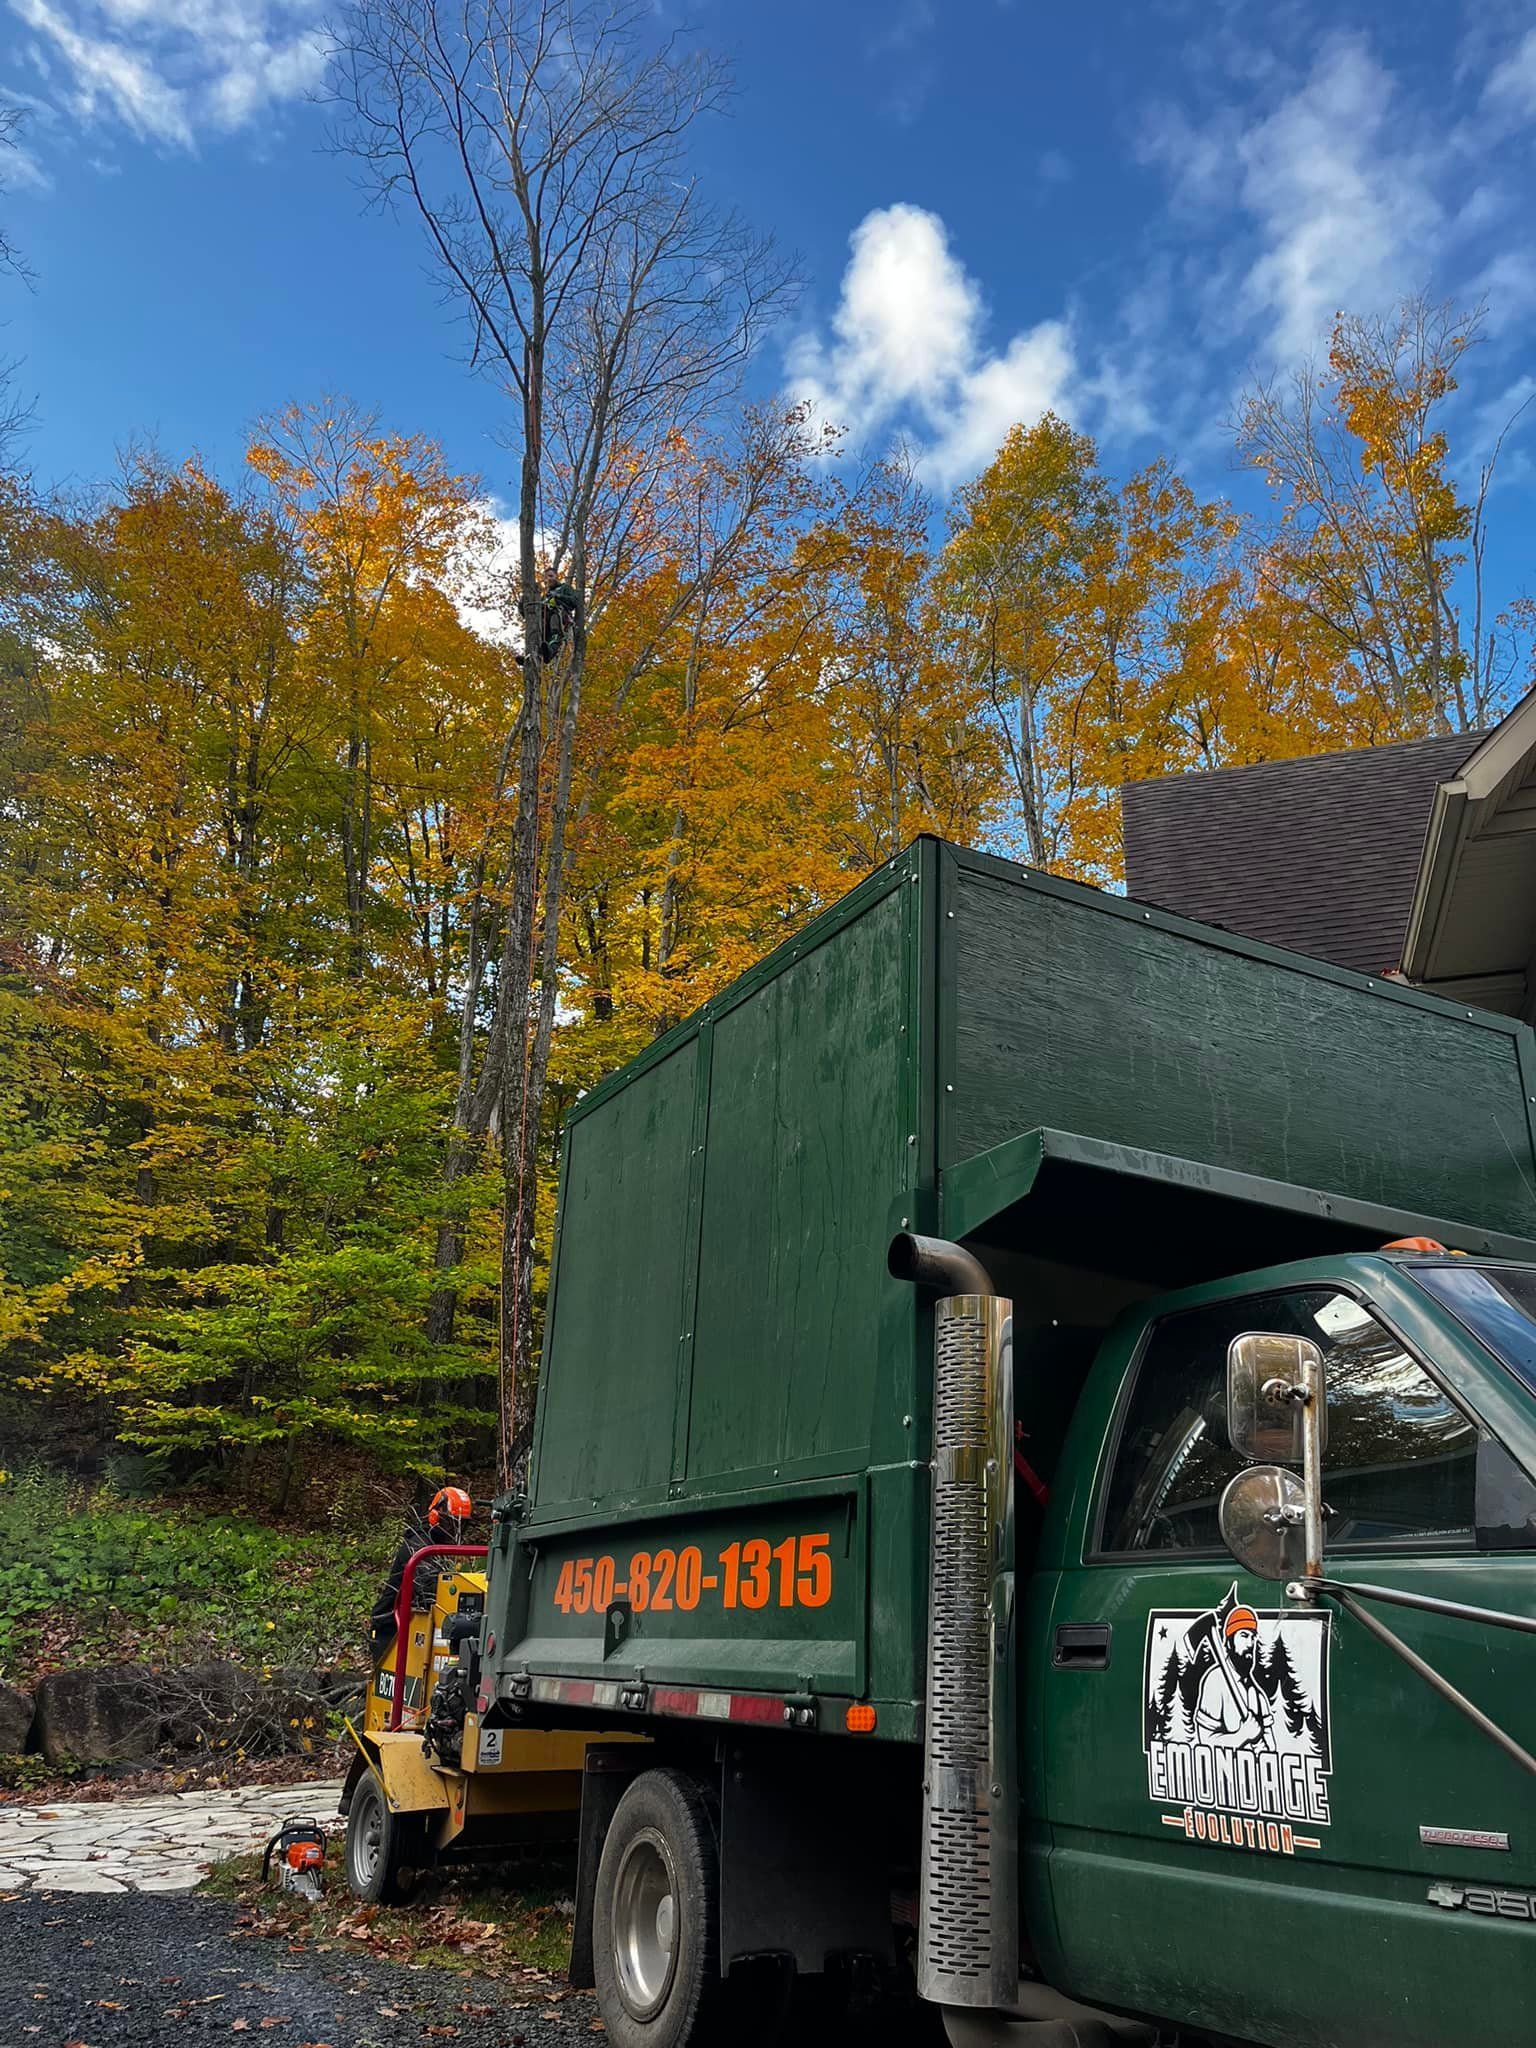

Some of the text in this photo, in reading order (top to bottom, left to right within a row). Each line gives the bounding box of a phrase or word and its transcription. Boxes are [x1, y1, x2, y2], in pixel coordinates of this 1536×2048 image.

[554, 1533, 832, 1614] 450-820-1315
[487, 1732, 497, 1747] 2
[1149, 1741, 1331, 1825] EMONDAGE
[1184, 1807, 1294, 1854] ÉVOLUTION
[1423, 1830, 1505, 1847] TURBO DIESEL
[1465, 1888, 1536, 1918] 35
